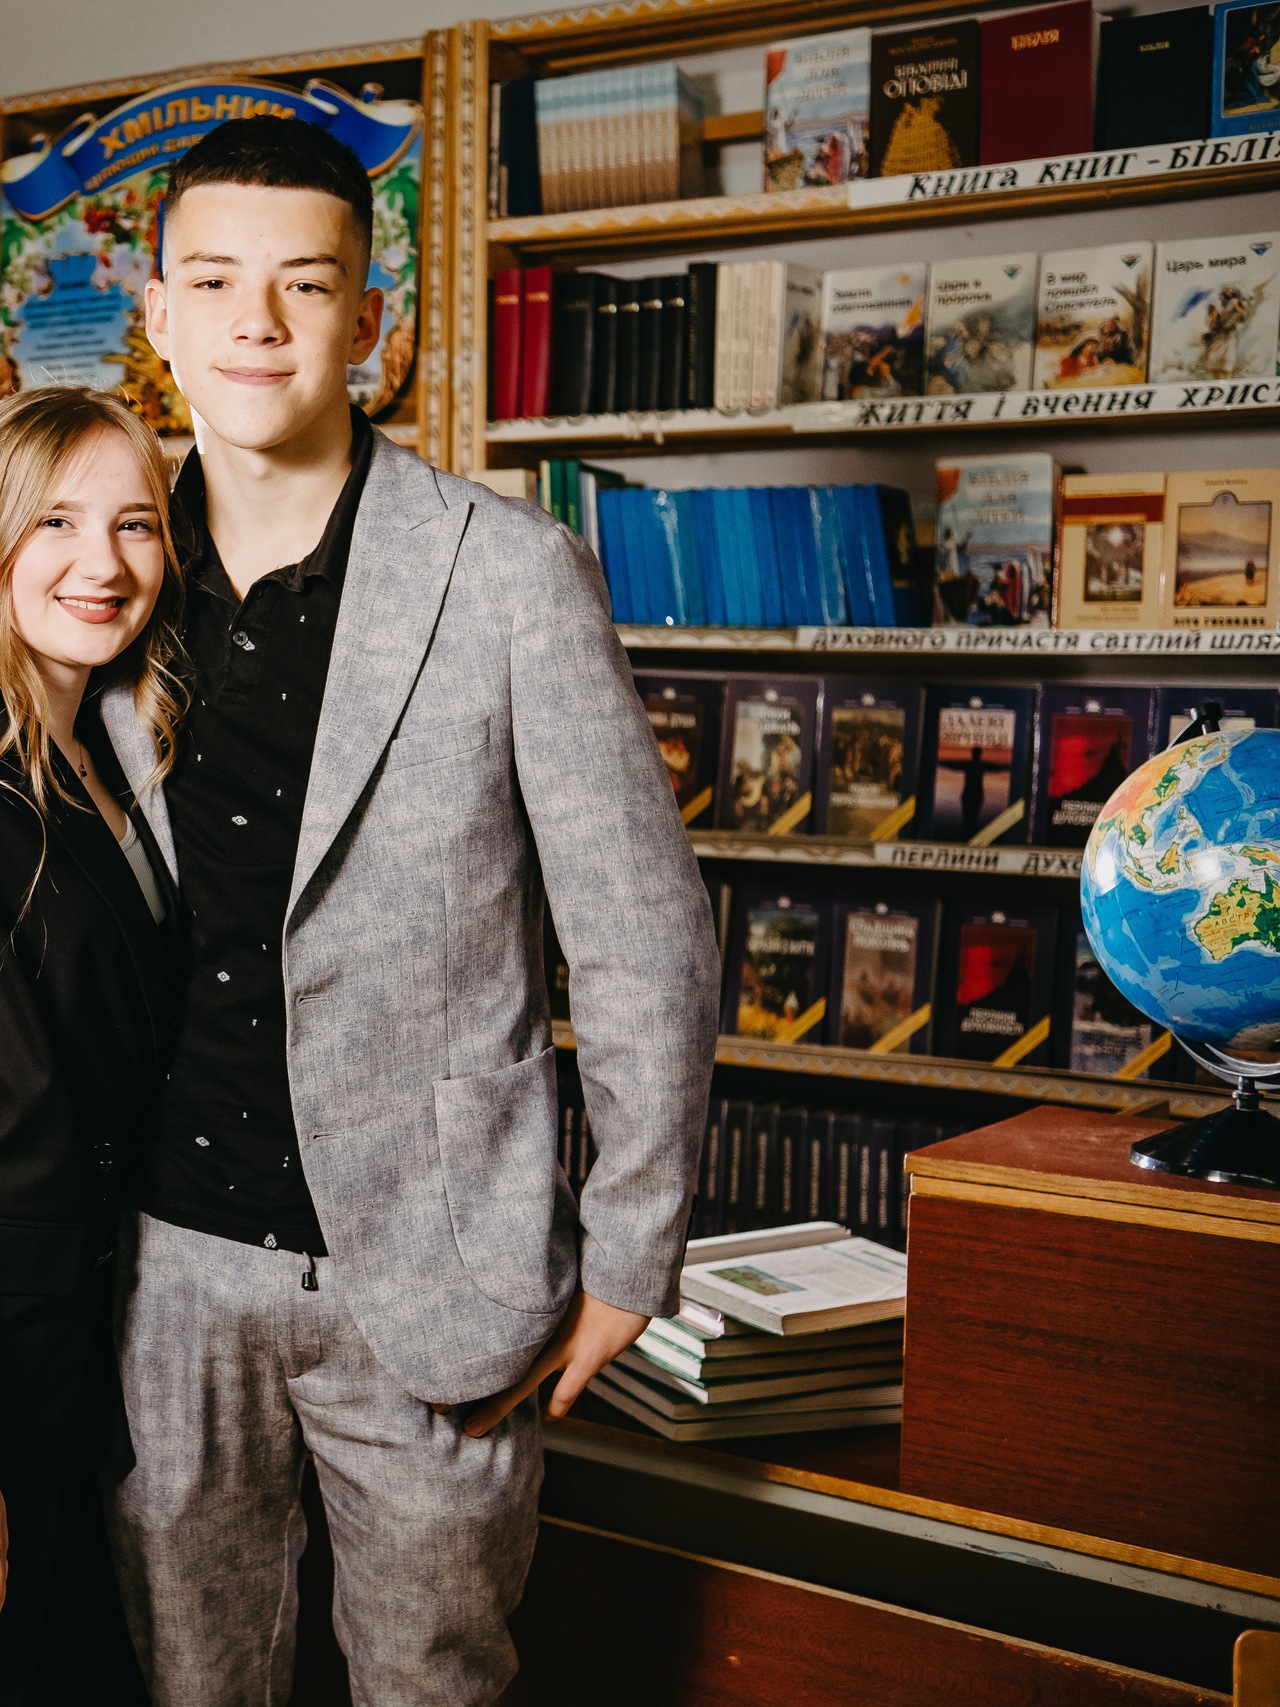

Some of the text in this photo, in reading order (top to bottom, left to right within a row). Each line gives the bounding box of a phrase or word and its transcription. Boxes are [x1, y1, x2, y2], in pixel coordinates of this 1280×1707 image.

[1011, 28, 1060, 51] БІБЛІЯ
[795, 44, 850, 63] БІБЛІЯ
[883, 71, 968, 98] ОПОВІДІ
[1166, 255, 1247, 274] Царь мира
[855, 398, 976, 427] ЖИТТЯ
[955, 630, 1079, 652] ПРИЧАСТЯ
[1090, 630, 1202, 650] СВІТЛИЙ
[1061, 800, 1103, 812] ПЕРЛИН
[891, 846, 1000, 869] ПЕРЛИНИ
